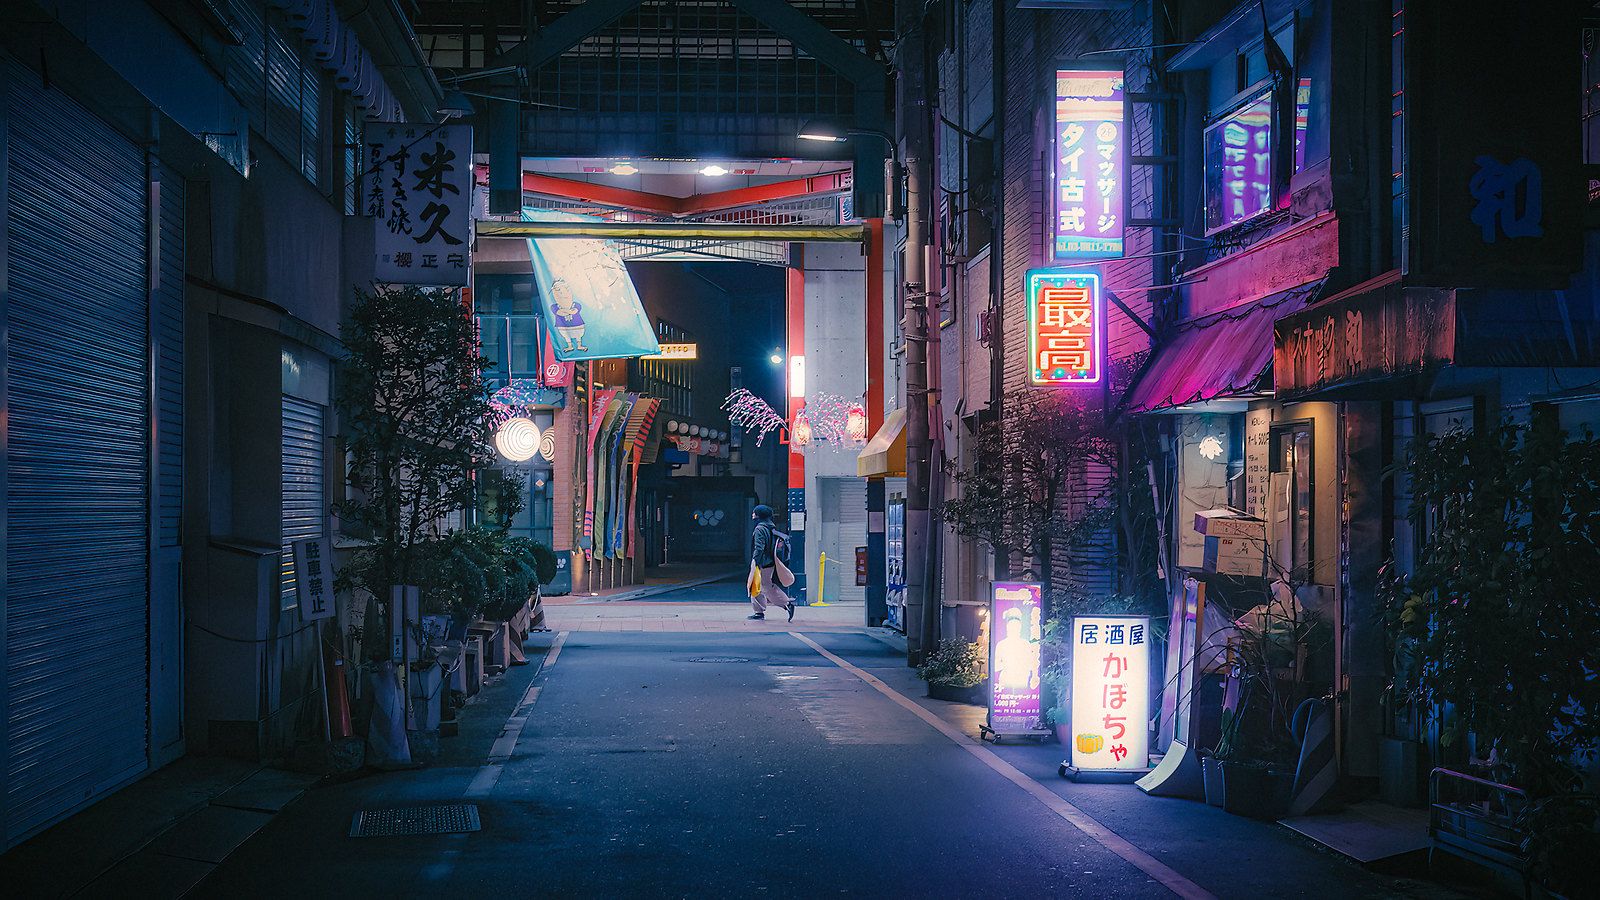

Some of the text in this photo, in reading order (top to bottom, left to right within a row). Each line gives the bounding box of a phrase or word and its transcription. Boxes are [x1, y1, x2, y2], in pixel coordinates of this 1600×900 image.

[412, 142, 464, 245] 米久
[1060, 122, 1086, 232] タイ古式
[1096, 144, 1117, 233] マッサージ
[1039, 288, 1092, 370] 最高
[305, 541, 326, 614] 駐車禁止
[1080, 624, 1144, 646] 居酒屋
[1102, 652, 1128, 762] かぼちゃ
